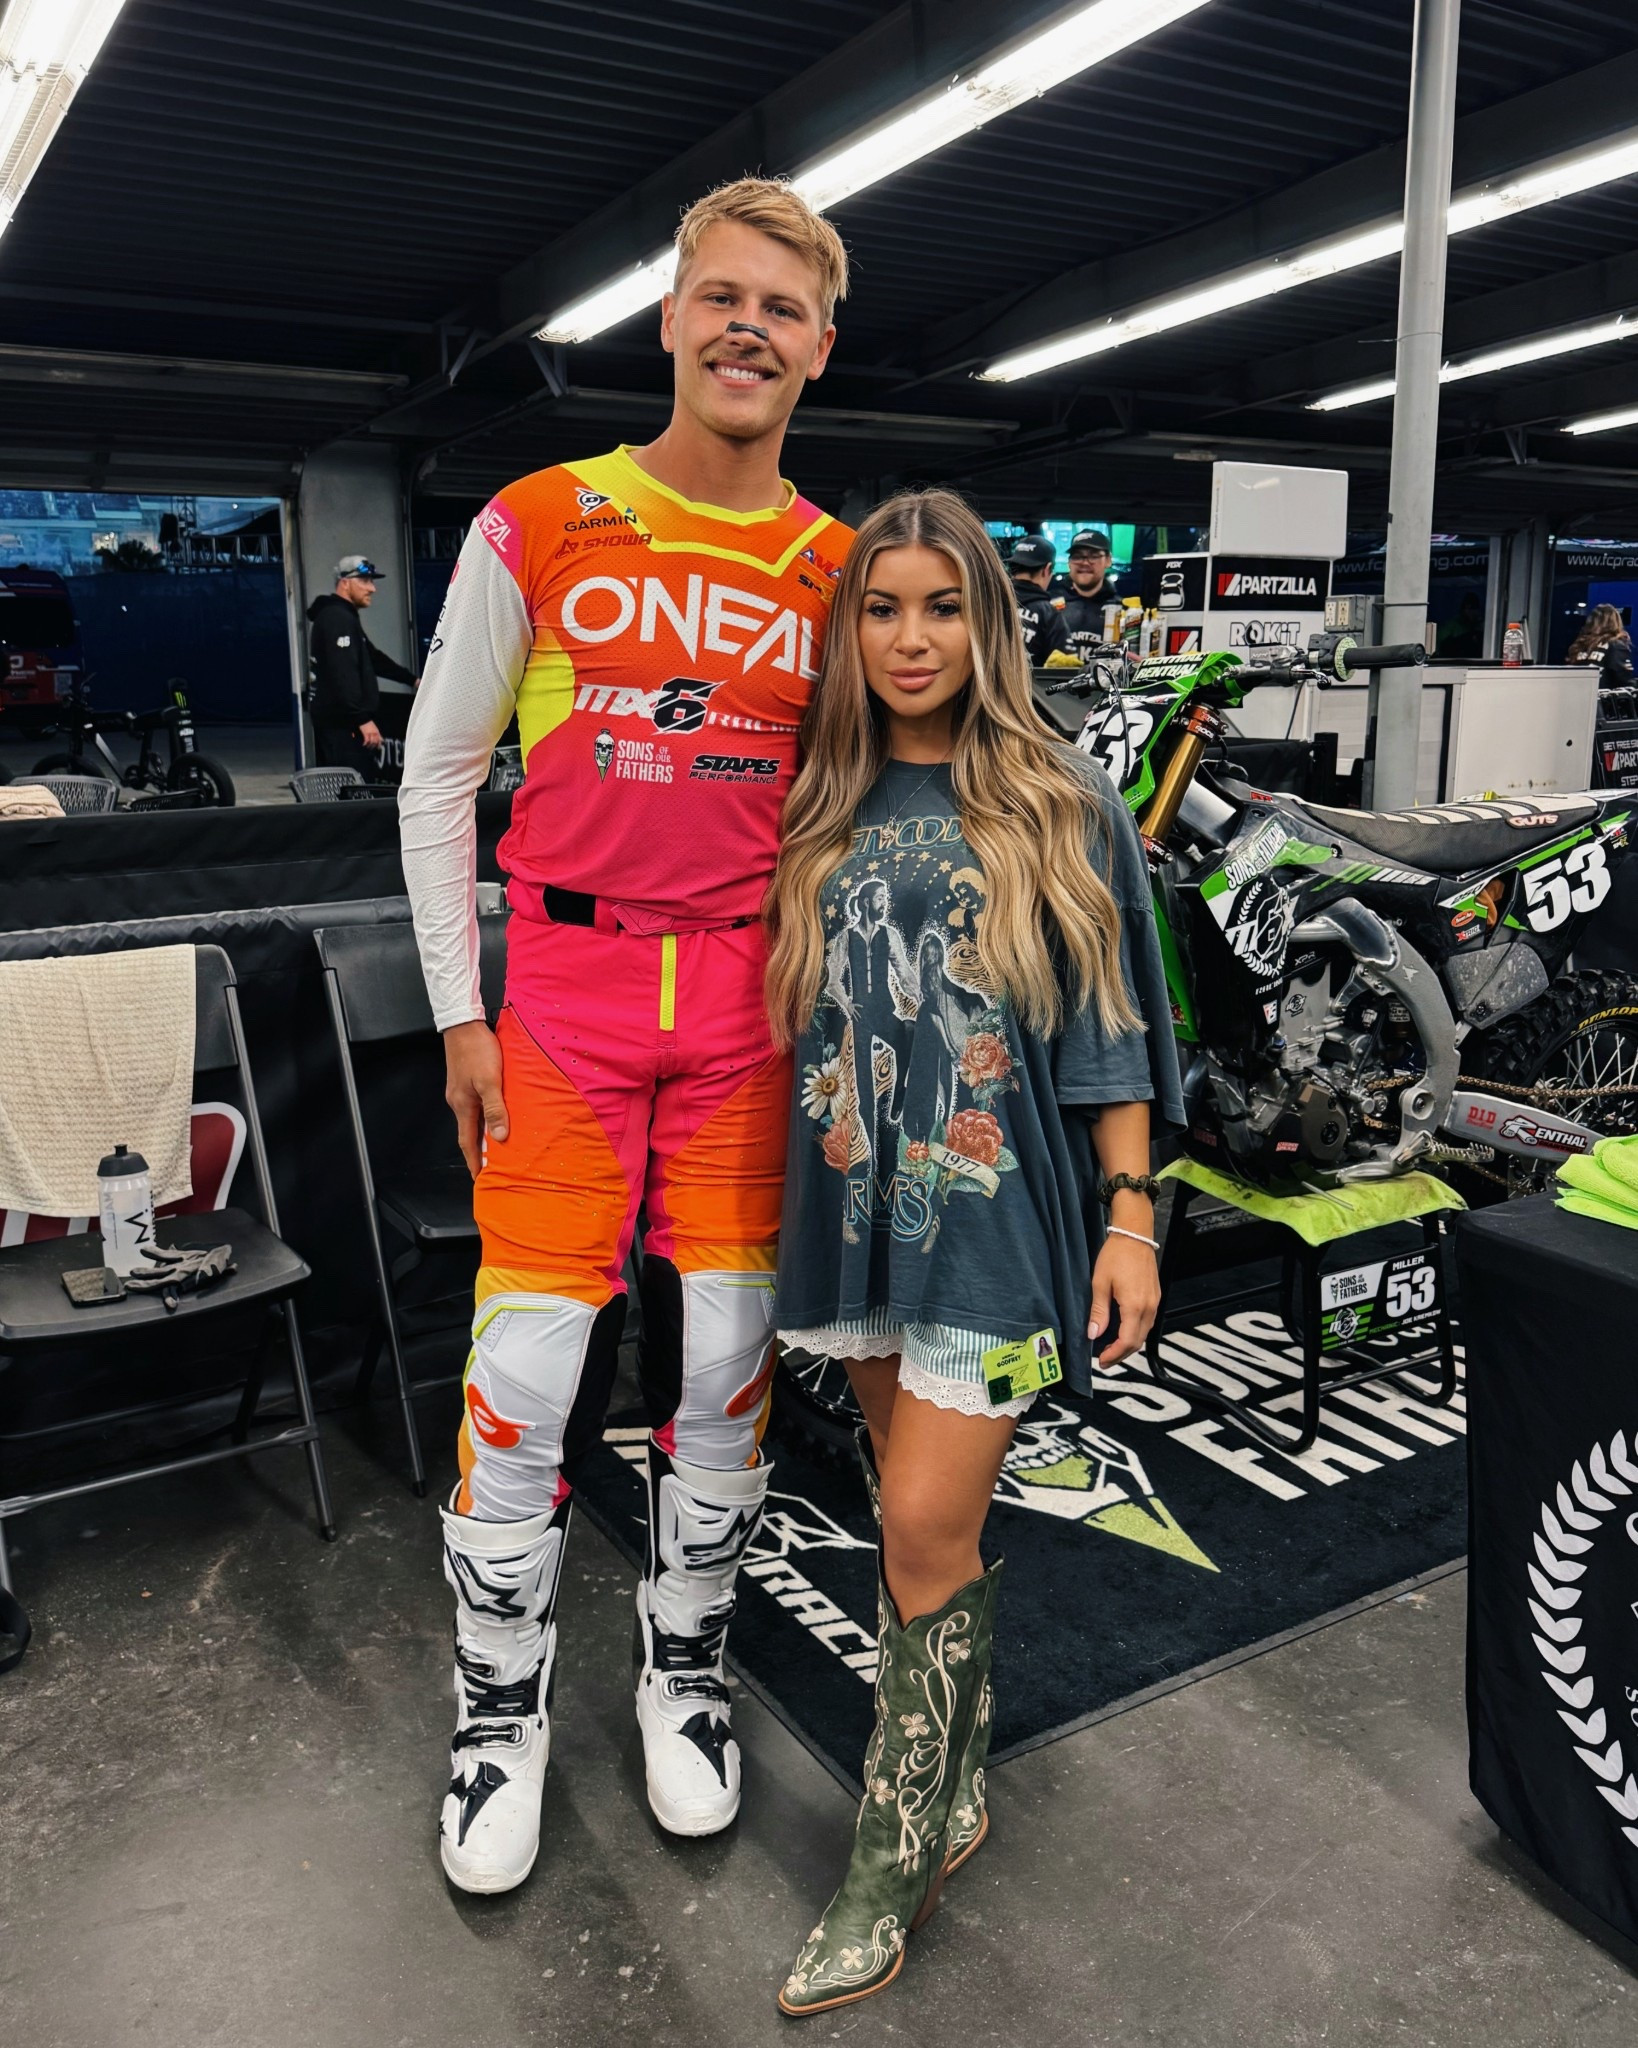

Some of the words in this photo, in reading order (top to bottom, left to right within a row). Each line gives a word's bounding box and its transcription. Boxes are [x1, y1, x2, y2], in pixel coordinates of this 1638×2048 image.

[564, 514, 638, 532] GARMIN
[582, 533, 653, 551] SHOWA
[1241, 575, 1317, 596] PARTZILLA
[561, 573, 821, 681] O'NEAL
[617, 739, 654, 762] SONS
[616, 761, 674, 784] FATHERS
[690, 754, 781, 775] STAPES
[689, 772, 778, 785] PERFORMANCE
[1509, 814, 1558, 828] GUTS
[1224, 855, 1257, 891] SONS
[1523, 842, 1612, 933] 53
[1578, 1005, 1638, 1030] DUNLOP
[941, 1150, 982, 1174] 1977
[1392, 1255, 1425, 1271] MILLER
[1339, 1275, 1356, 1289] SONS
[1340, 1283, 1368, 1300] FATHERS
[1386, 1266, 1435, 1318] 53
[1401, 1316, 1413, 1326] JOE
[1038, 1357, 1058, 1383] L5
